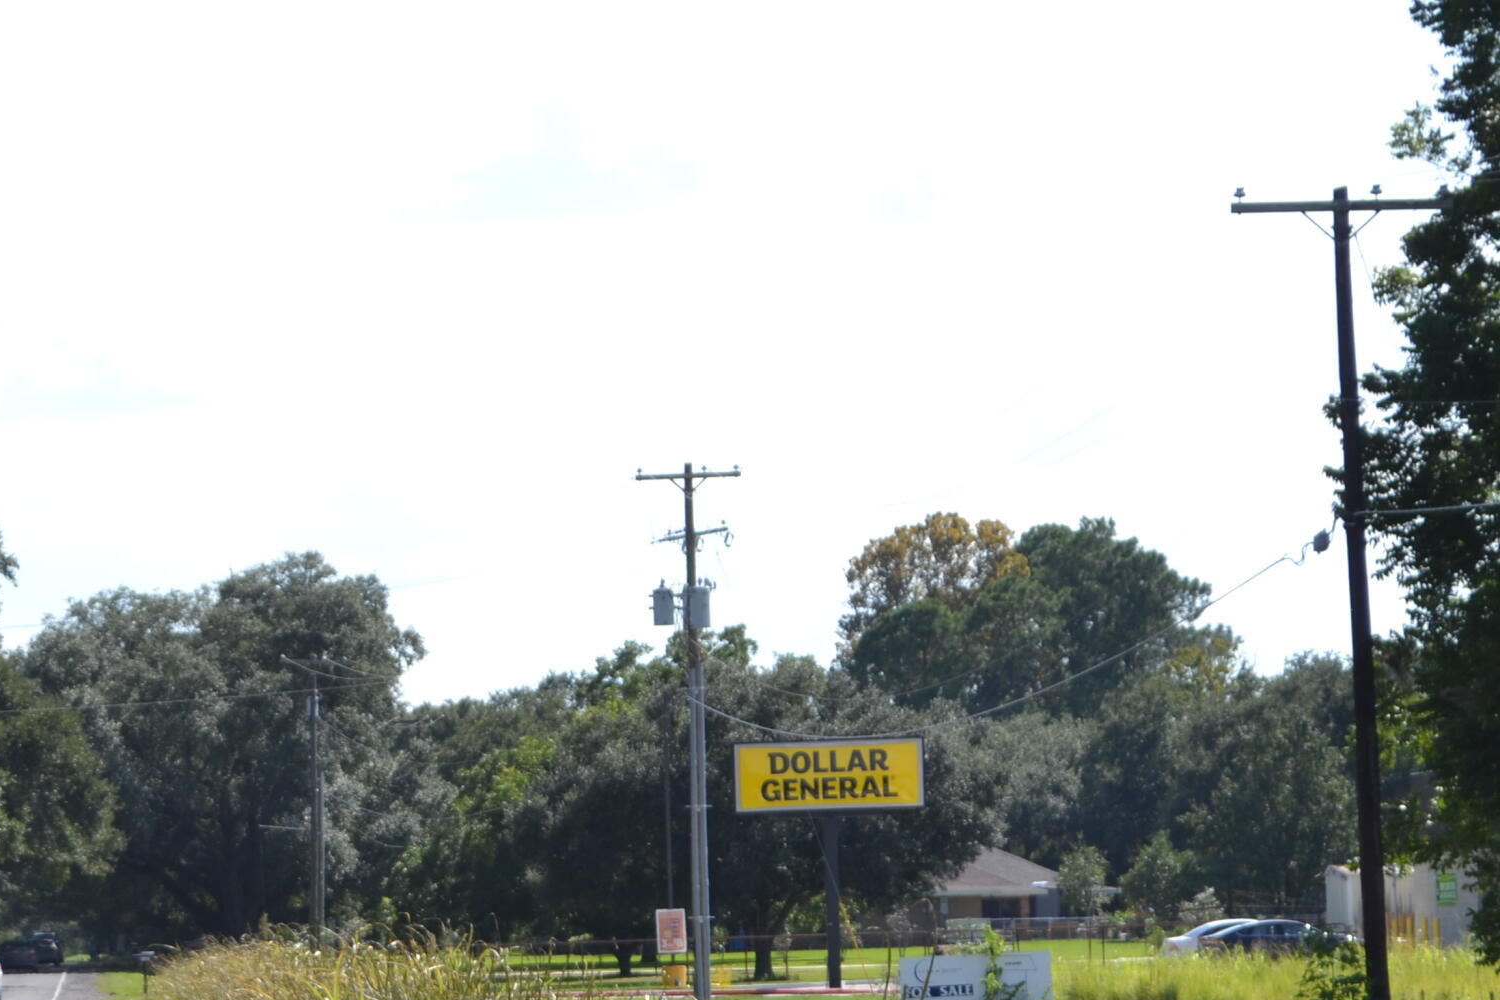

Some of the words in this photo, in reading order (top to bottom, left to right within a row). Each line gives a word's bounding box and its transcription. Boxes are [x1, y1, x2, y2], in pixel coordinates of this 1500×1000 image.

[768, 749, 889, 775] DOLLAR
[761, 775, 898, 801] GENERAL
[939, 984, 973, 996] SALE
